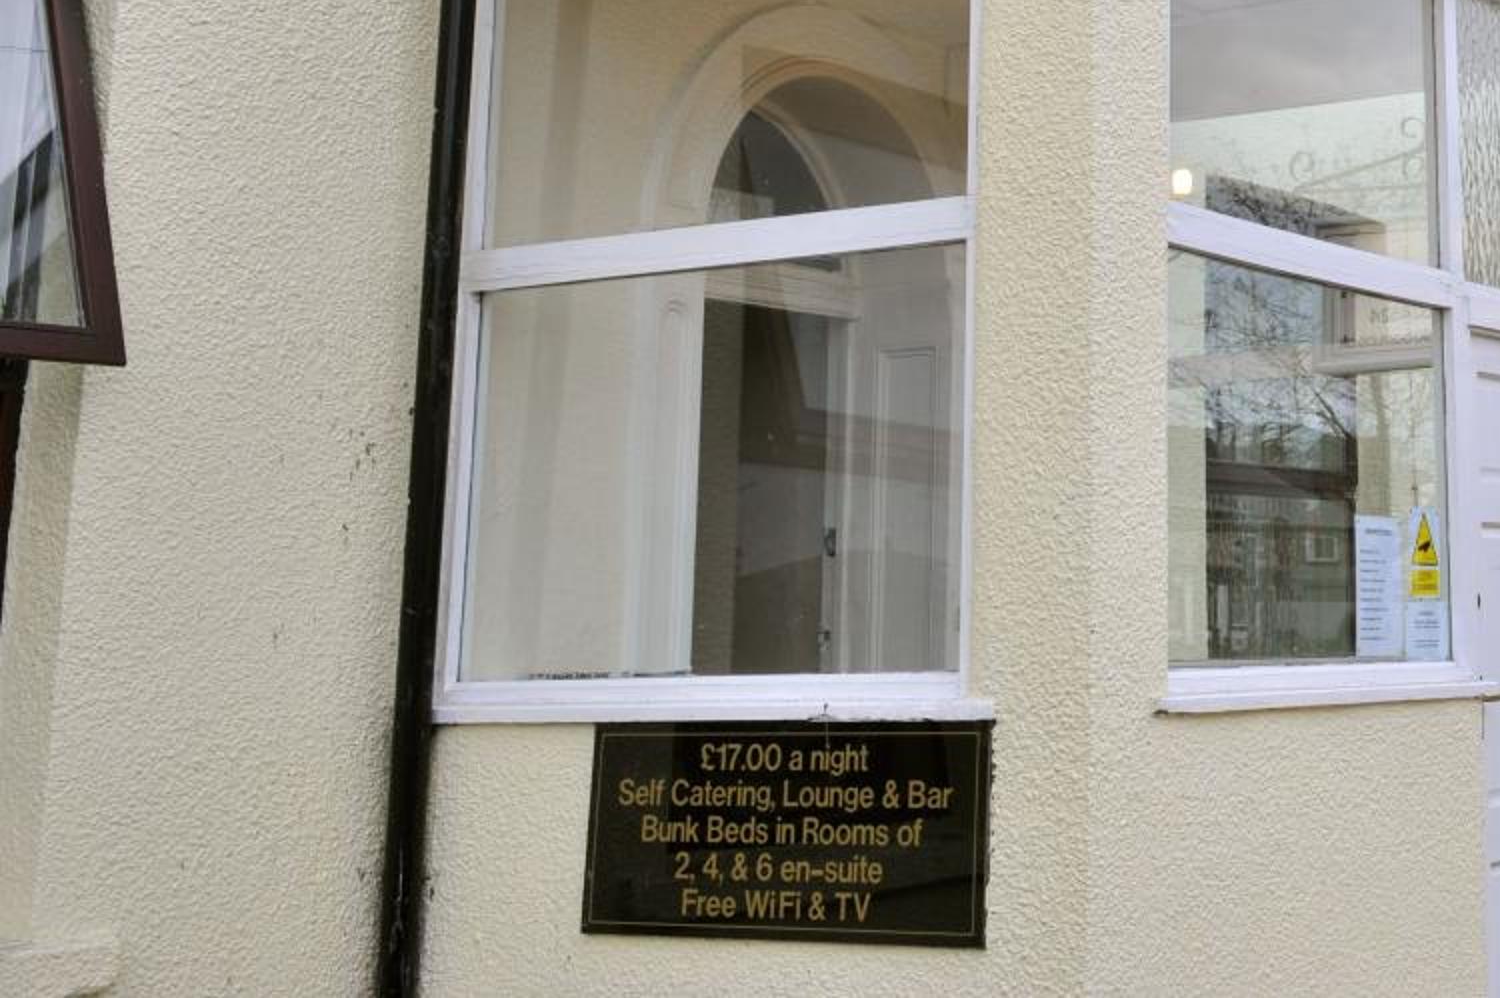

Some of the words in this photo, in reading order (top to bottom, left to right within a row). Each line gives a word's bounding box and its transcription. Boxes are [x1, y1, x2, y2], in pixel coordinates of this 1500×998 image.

[701, 743, 782, 771] £17.00
[788, 750, 803, 771] a
[809, 743, 869, 777] night
[617, 777, 666, 806] Self
[671, 779, 776, 813] Catering,
[783, 779, 875, 813] Lounge
[882, 779, 900, 809] &
[907, 780, 955, 810] Bar
[641, 815, 699, 843] Bunk
[707, 816, 769, 844] Beds
[775, 816, 796, 845] in
[802, 816, 889, 846] Rooms
[896, 818, 923, 847] of
[674, 851, 696, 883] 2,
[702, 852, 724, 885] 4,
[730, 852, 749, 882] &
[756, 853, 774, 882] 6
[780, 854, 884, 884] en-suite
[681, 888, 737, 917] Free
[808, 891, 826, 921] &
[835, 892, 871, 923] TV
